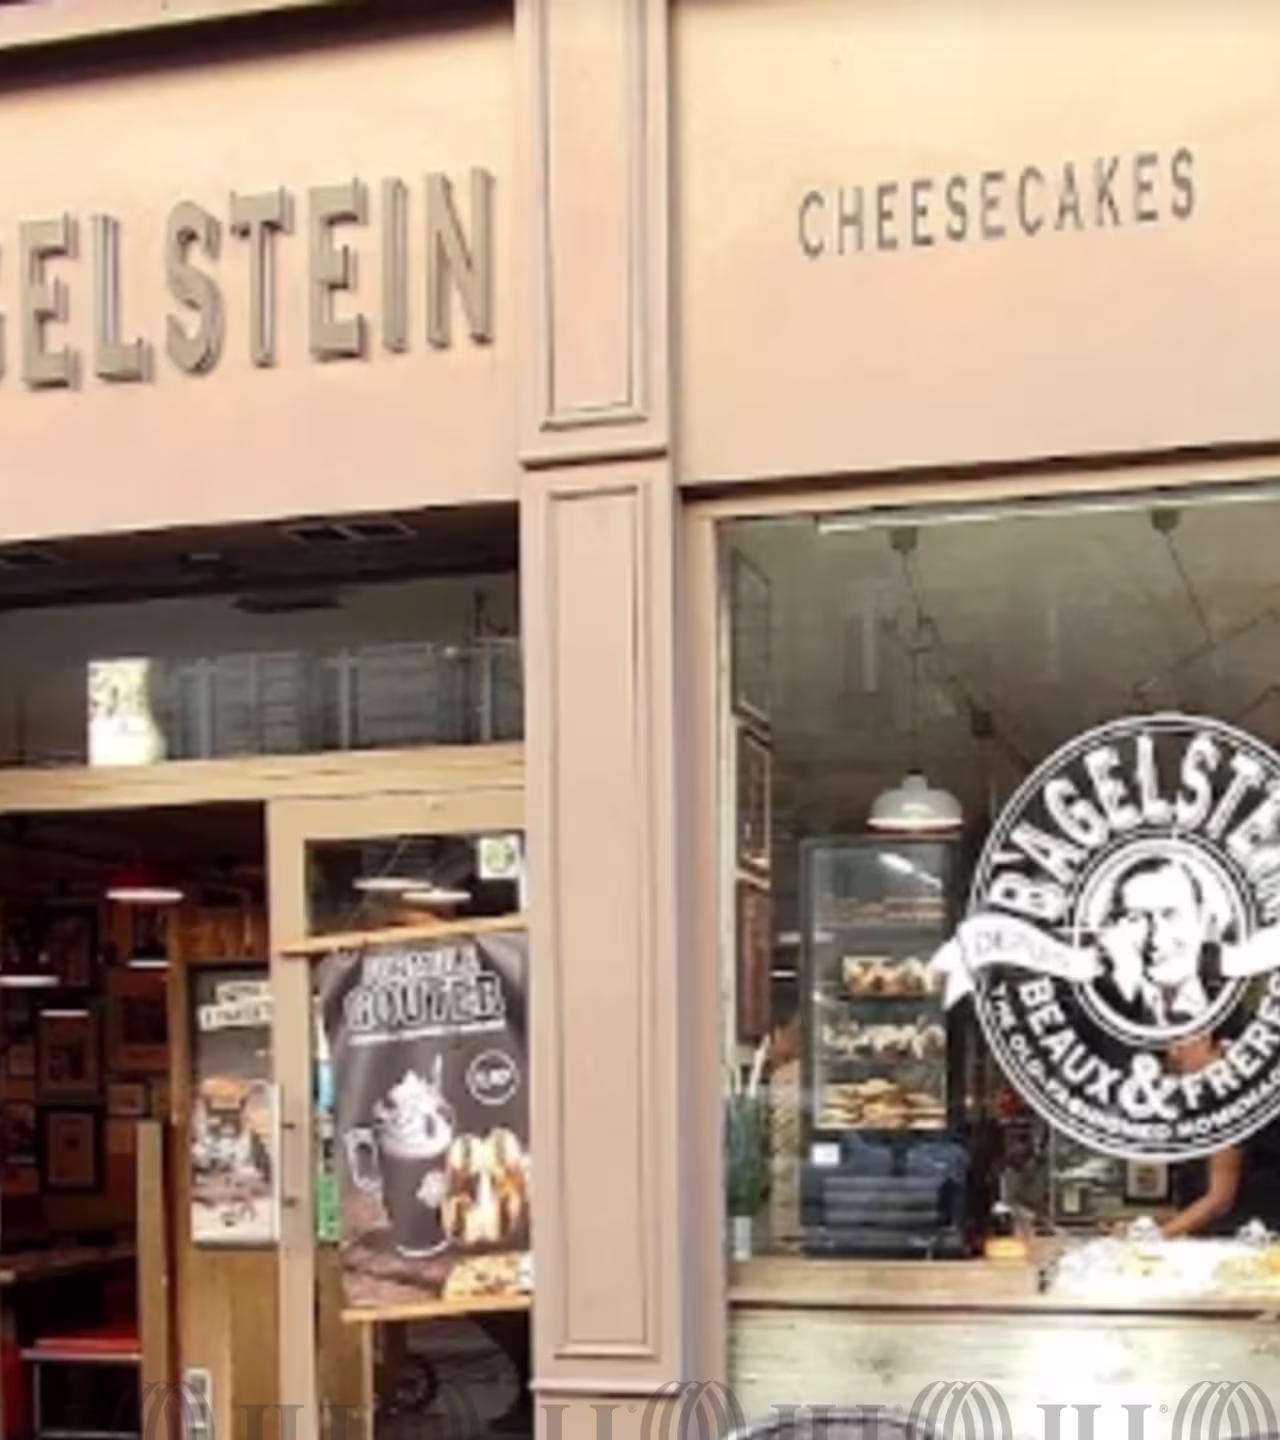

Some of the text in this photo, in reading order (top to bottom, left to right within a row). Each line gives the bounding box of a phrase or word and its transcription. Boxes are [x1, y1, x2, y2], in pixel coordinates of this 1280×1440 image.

[797, 147, 1198, 259] CHEESECAKES
[1018, 975, 1123, 1107] BEAUX
[1118, 1052, 1180, 1120] &
